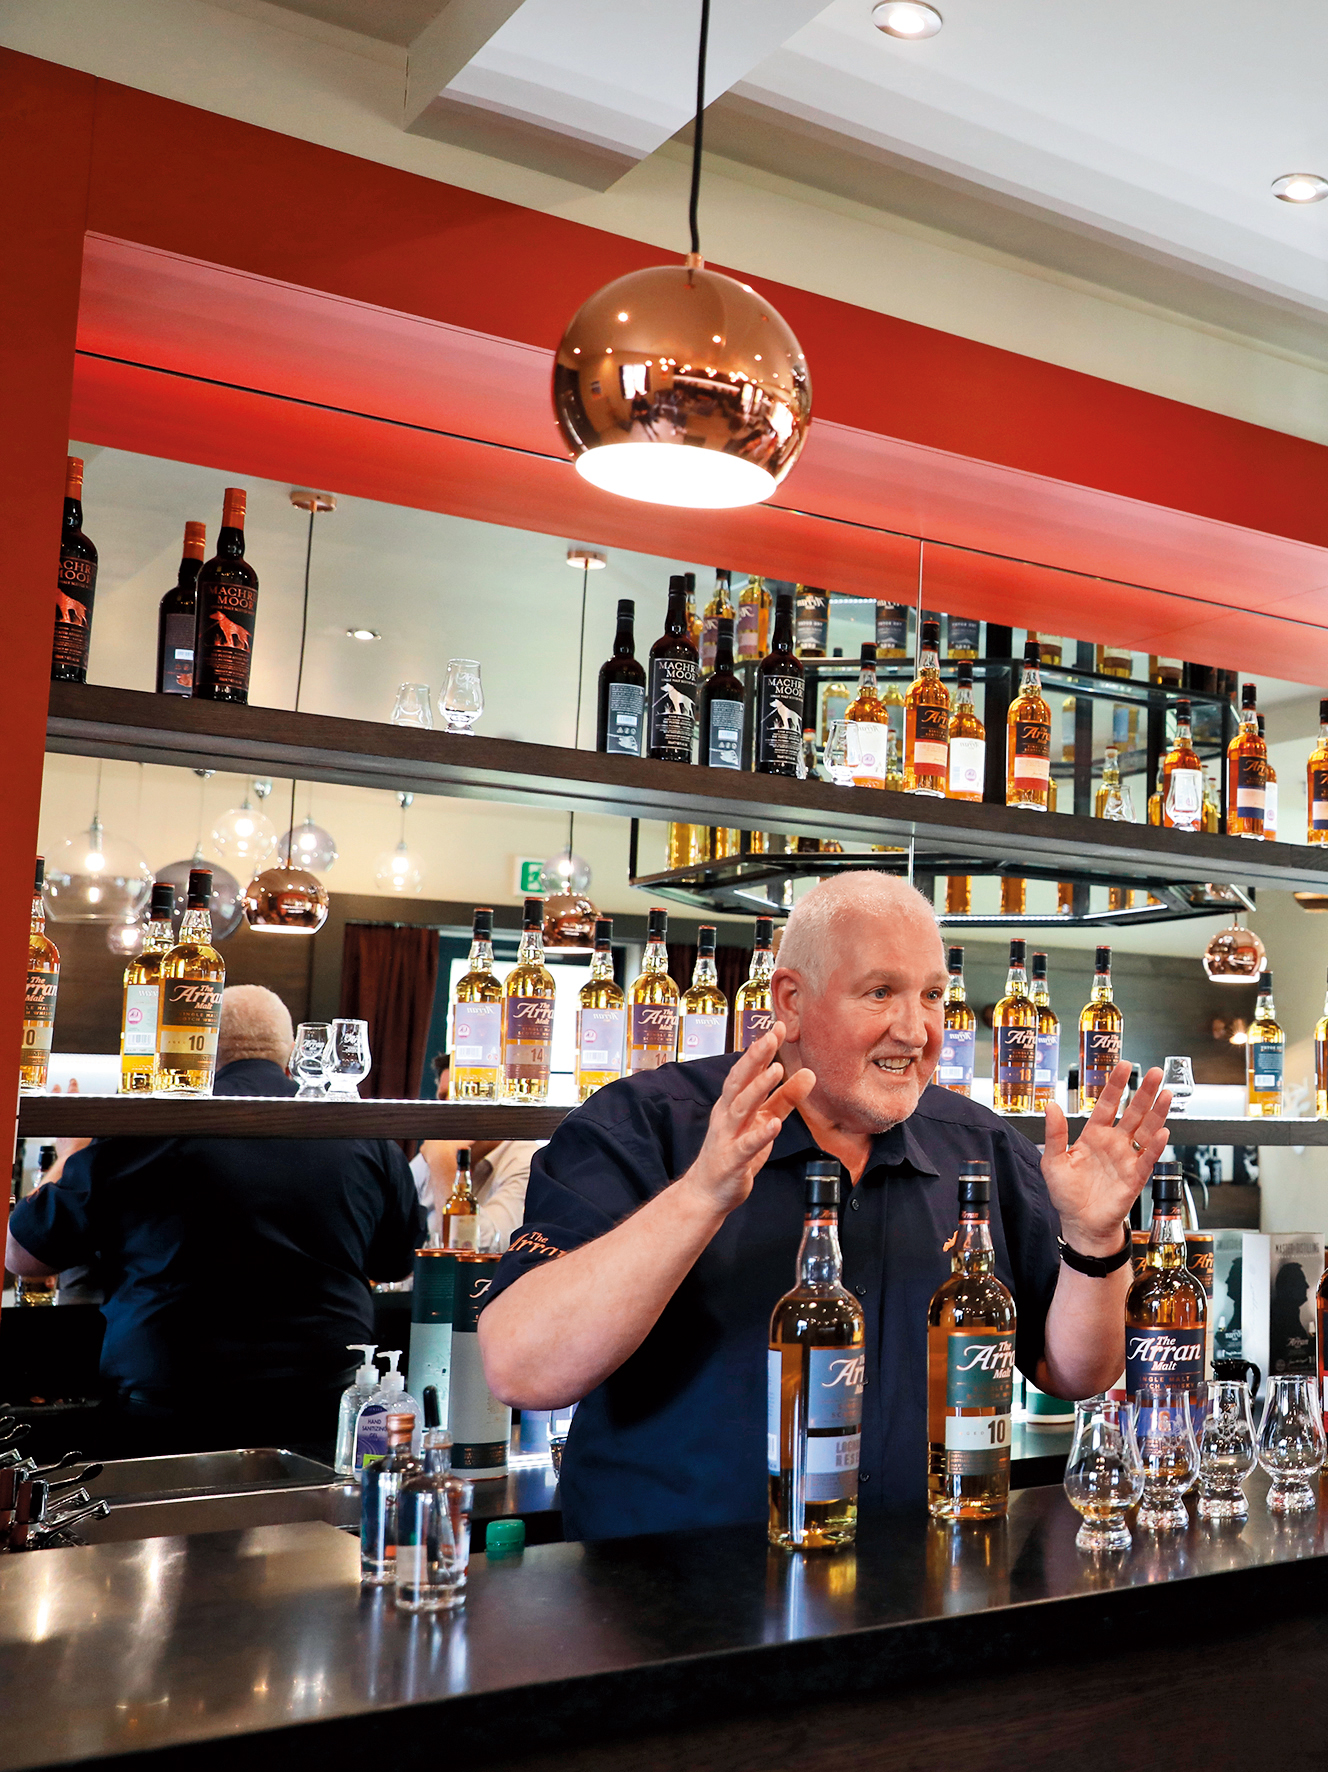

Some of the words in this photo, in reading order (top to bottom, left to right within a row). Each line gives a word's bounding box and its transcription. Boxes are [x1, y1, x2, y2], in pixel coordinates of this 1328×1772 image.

[209, 586, 258, 601] MACHR
[658, 661, 699, 675] MACHR
[768, 678, 805, 691] MACHR
[921, 710, 949, 723] Arr
[1021, 726, 1050, 739] Arra
[30, 976, 46, 984] The
[512, 1002, 555, 1019] Arra
[638, 1009, 679, 1025] Arra
[188, 1035, 205, 1051] 10
[1005, 1030, 1036, 1044] Arra
[1090, 1034, 1122, 1048] Arra
[531, 1048, 544, 1062] 14
[655, 1053, 667, 1066] 14
[1019, 1068, 1032, 1081] 18
[530, 1231, 549, 1243] The
[1188, 1253, 1214, 1269] Arr
[999, 1340, 1012, 1351] The
[1156, 1336, 1177, 1346] The
[1127, 1337, 1202, 1362] Arran
[956, 1344, 1016, 1371] Arra
[821, 1358, 865, 1388] Arr
[1151, 1361, 1178, 1371] Malt
[993, 1368, 1012, 1379] Malt
[987, 1419, 1006, 1444] 10
